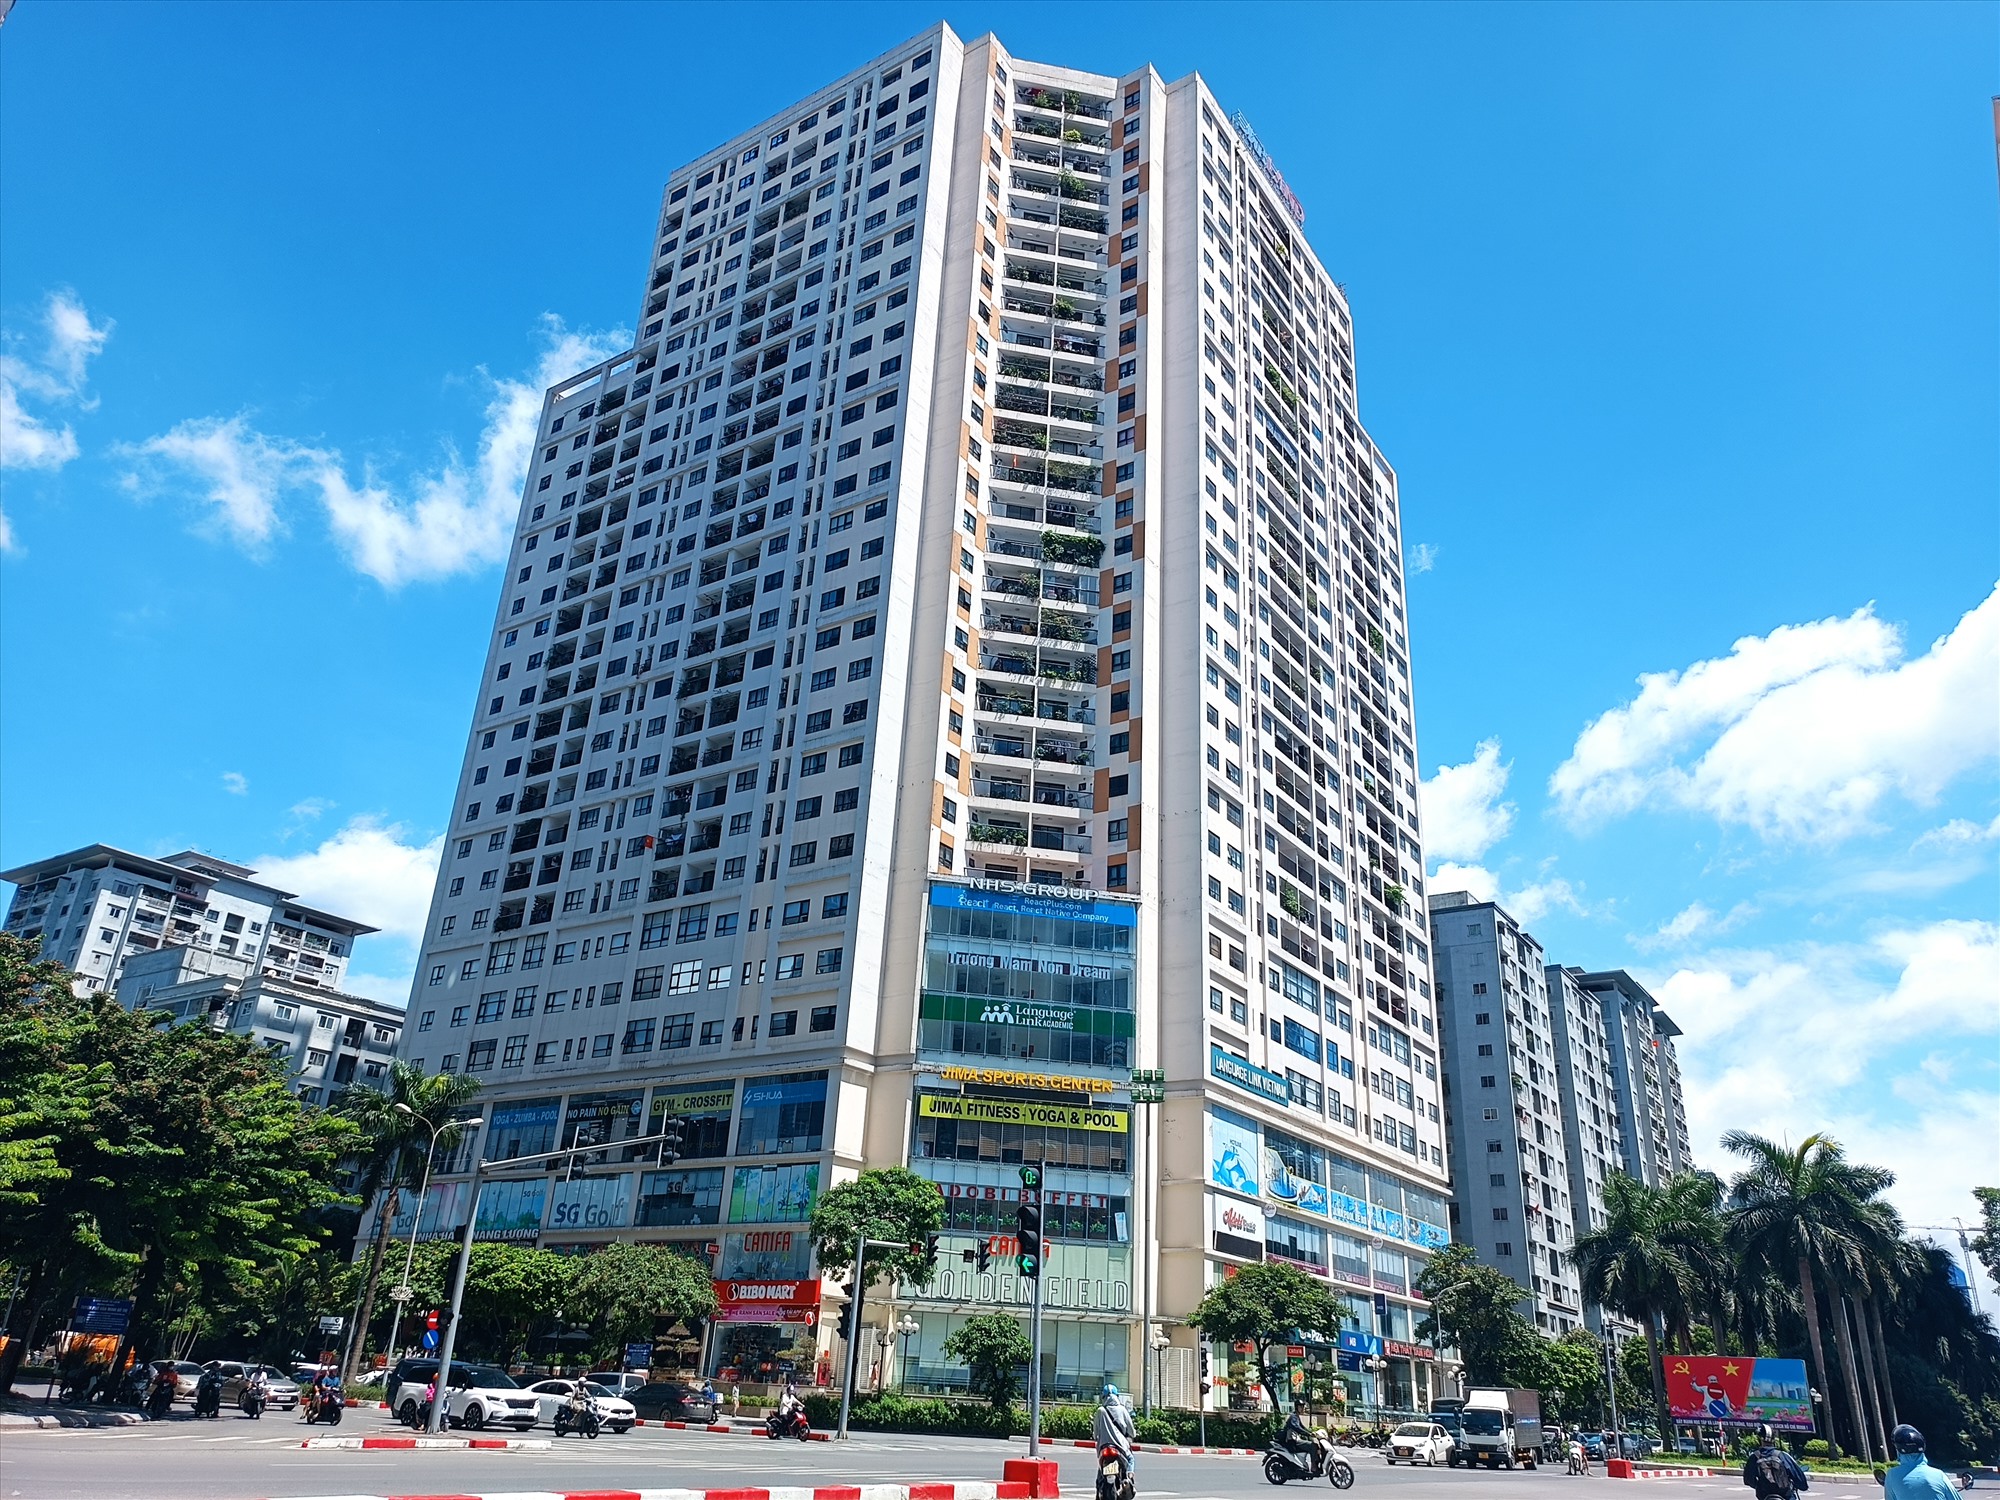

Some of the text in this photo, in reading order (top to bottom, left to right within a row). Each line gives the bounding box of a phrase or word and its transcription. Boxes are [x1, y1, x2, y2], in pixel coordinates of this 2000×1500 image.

[969, 876, 1100, 901] NHS GROUP
[1024, 897, 1082, 910] ReactPlus.com
[1021, 905, 1043, 914] React
[1045, 908, 1071, 917] Native
[1073, 911, 1109, 923] Company
[1038, 959, 1064, 975] Non
[1070, 963, 1111, 980] Dream
[1016, 1004, 1074, 1021] Language
[1016, 1014, 1074, 1030] Link ACADEMIC
[941, 1067, 1113, 1093] JIMA SPORTS CENTER
[1215, 1054, 1287, 1099] LANGUAGE LINK VIETNAM
[653, 1099, 675, 1112] GYM
[683, 1093, 733, 1109] CROSSFIT
[753, 1090, 783, 1102] SHUA
[493, 1114, 510, 1126] YOGA
[513, 1112, 536, 1124] ZUMBA
[541, 1110, 558, 1121] POOL
[567, 1104, 630, 1119] NO PAIN NO GAIN
[929, 1099, 963, 1115] JIMA
[966, 1102, 1020, 1120] FITNESS
[1029, 1108, 1066, 1124] YOGA
[1070, 1111, 1081, 1125] &
[1084, 1113, 1119, 1128] POOL
[666, 1182, 682, 1193] SG
[554, 1197, 625, 1227] SG Golf
[743, 1231, 791, 1252] CANIFA
[988, 1235, 1051, 1258] CANA
[739, 1284, 796, 1300] BIBO MART
[1047, 1276, 1129, 1311] FIELD
